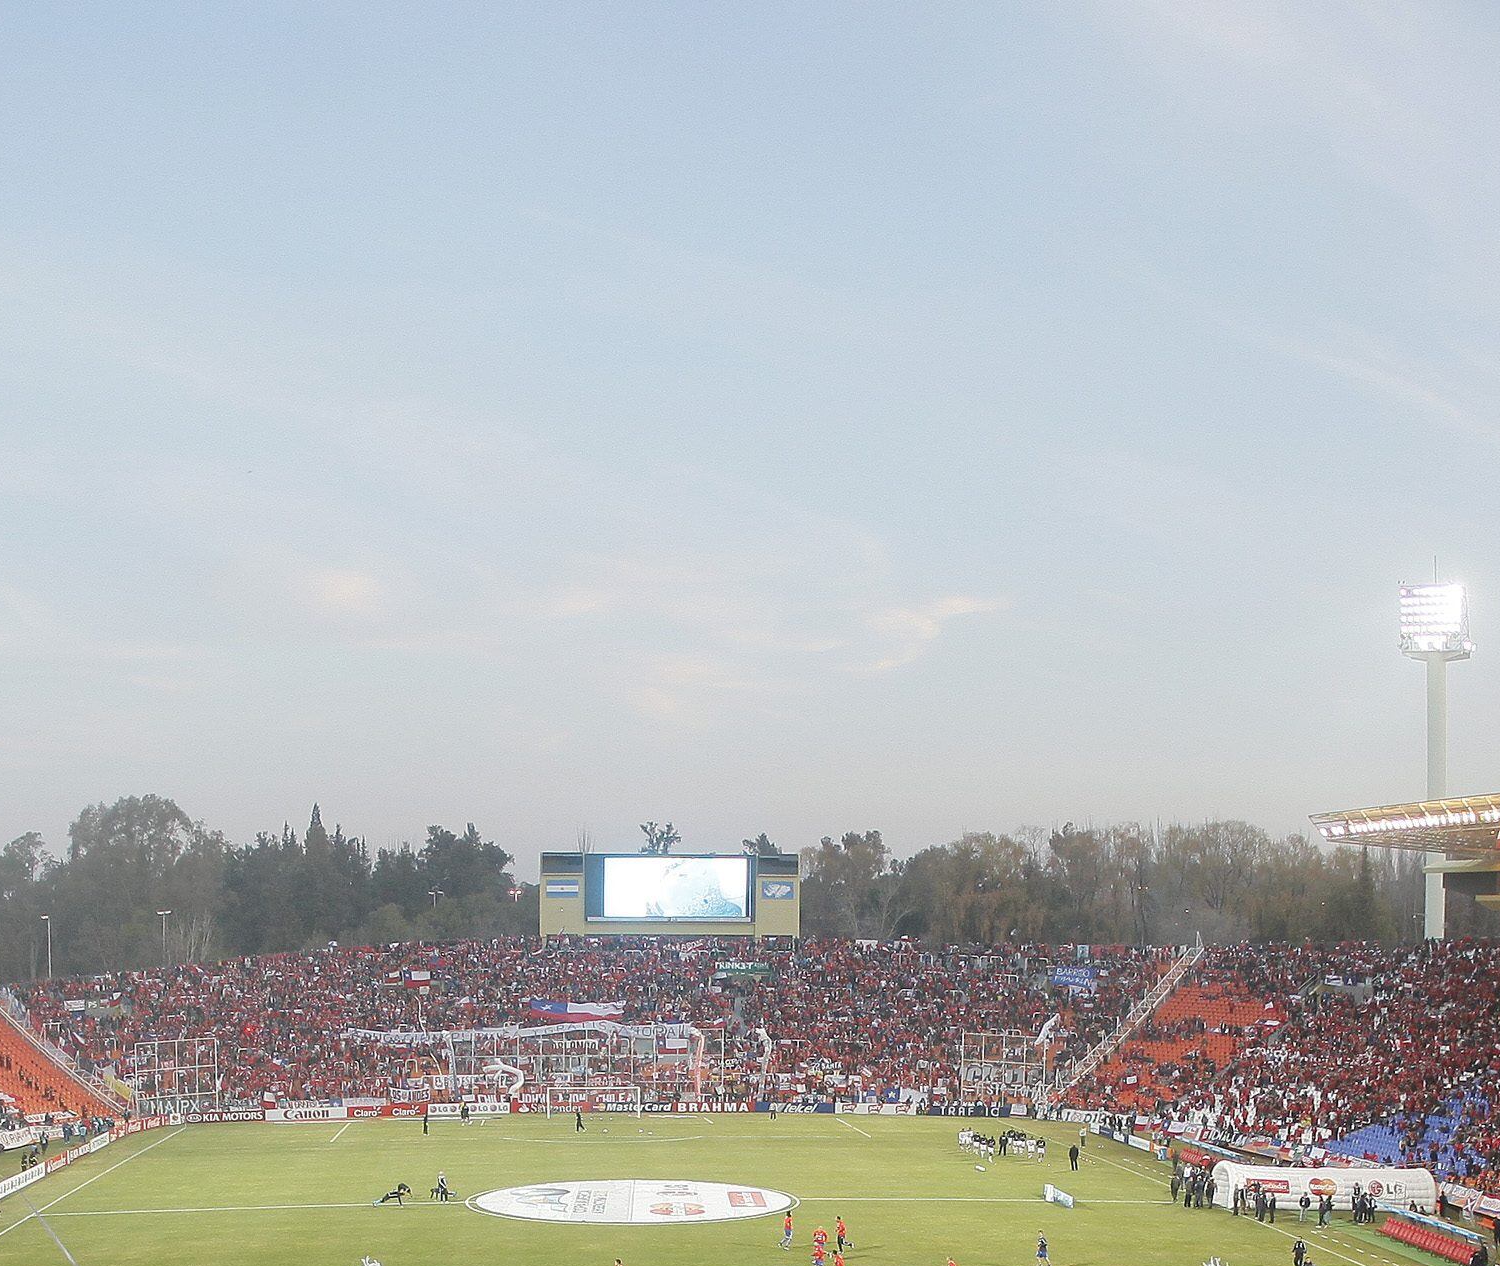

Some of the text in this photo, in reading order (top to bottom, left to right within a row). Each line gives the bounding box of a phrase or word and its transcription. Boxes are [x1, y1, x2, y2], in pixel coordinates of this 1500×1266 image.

[353, 1107, 416, 1118] Claro Claro
[438, 1104, 449, 1112] LG
[606, 1102, 673, 1112] MasterCard
[677, 1101, 750, 1113] BRAHMA
[202, 1112, 220, 1122] KIA
[221, 1111, 264, 1121] MOTORS
[284, 1108, 330, 1120] Canon
[1386, 1183, 1404, 1195] LG
